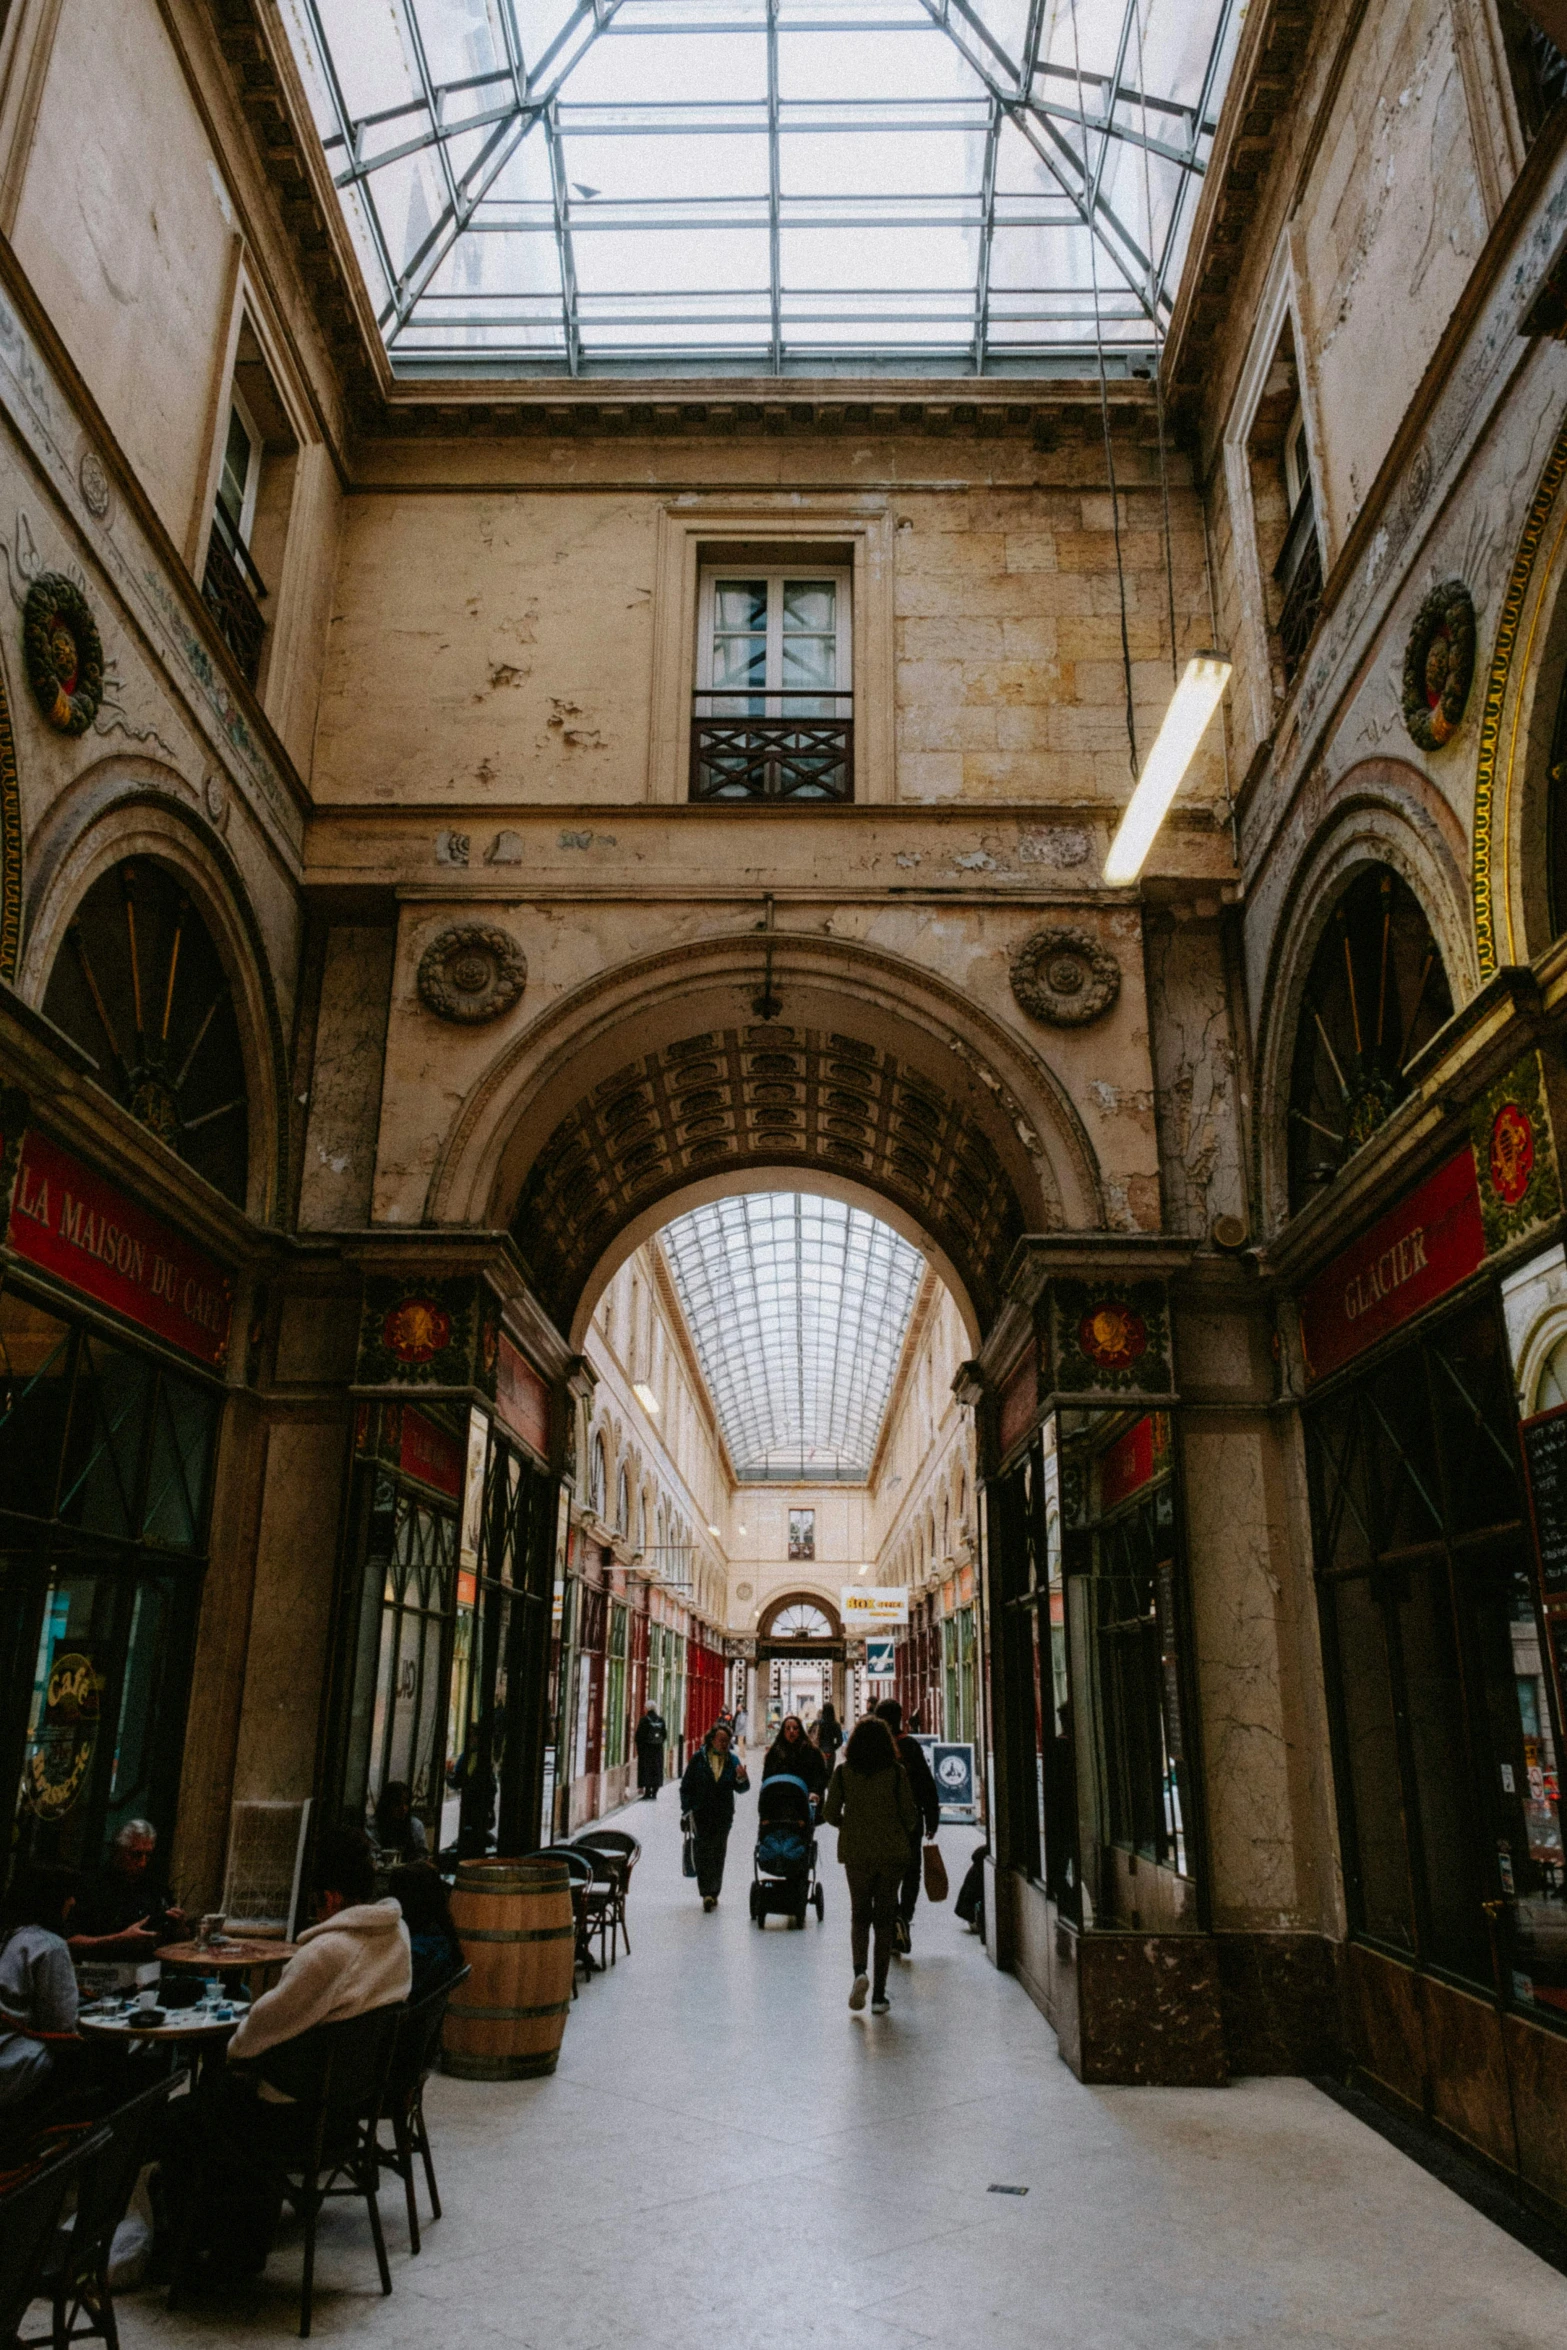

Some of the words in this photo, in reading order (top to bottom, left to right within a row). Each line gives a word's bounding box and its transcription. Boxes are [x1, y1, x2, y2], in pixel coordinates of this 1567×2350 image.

[17, 1166, 50, 1228] LA
[60, 1193, 146, 1282] MAISON
[152, 1255, 179, 1304] DU
[1344, 1227, 1429, 1321] GLACIER
